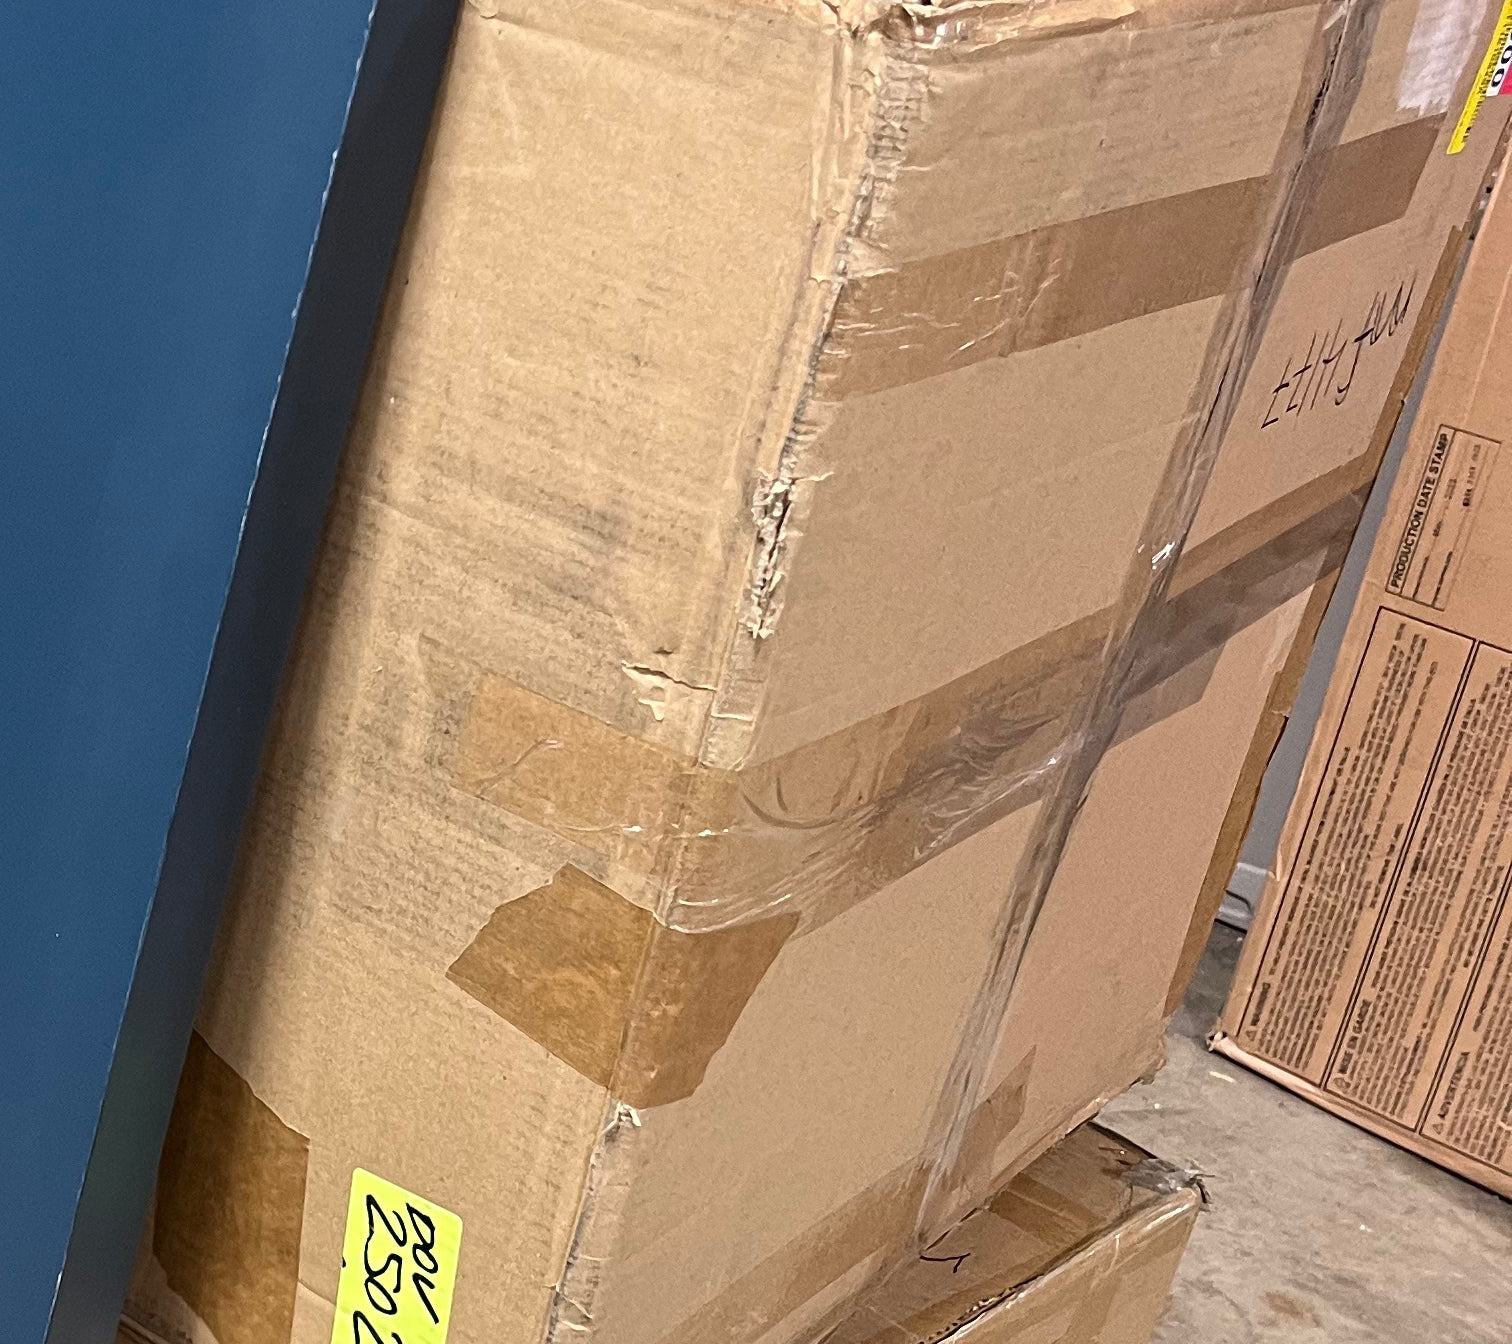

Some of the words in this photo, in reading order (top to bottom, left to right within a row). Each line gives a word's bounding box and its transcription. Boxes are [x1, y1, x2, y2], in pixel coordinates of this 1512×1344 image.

[1390, 509, 1424, 588] PRODUCTION
[1416, 477, 1436, 507] DATE
[1429, 433, 1448, 474] STAMP
[405, 1202, 439, 1324] DOV
